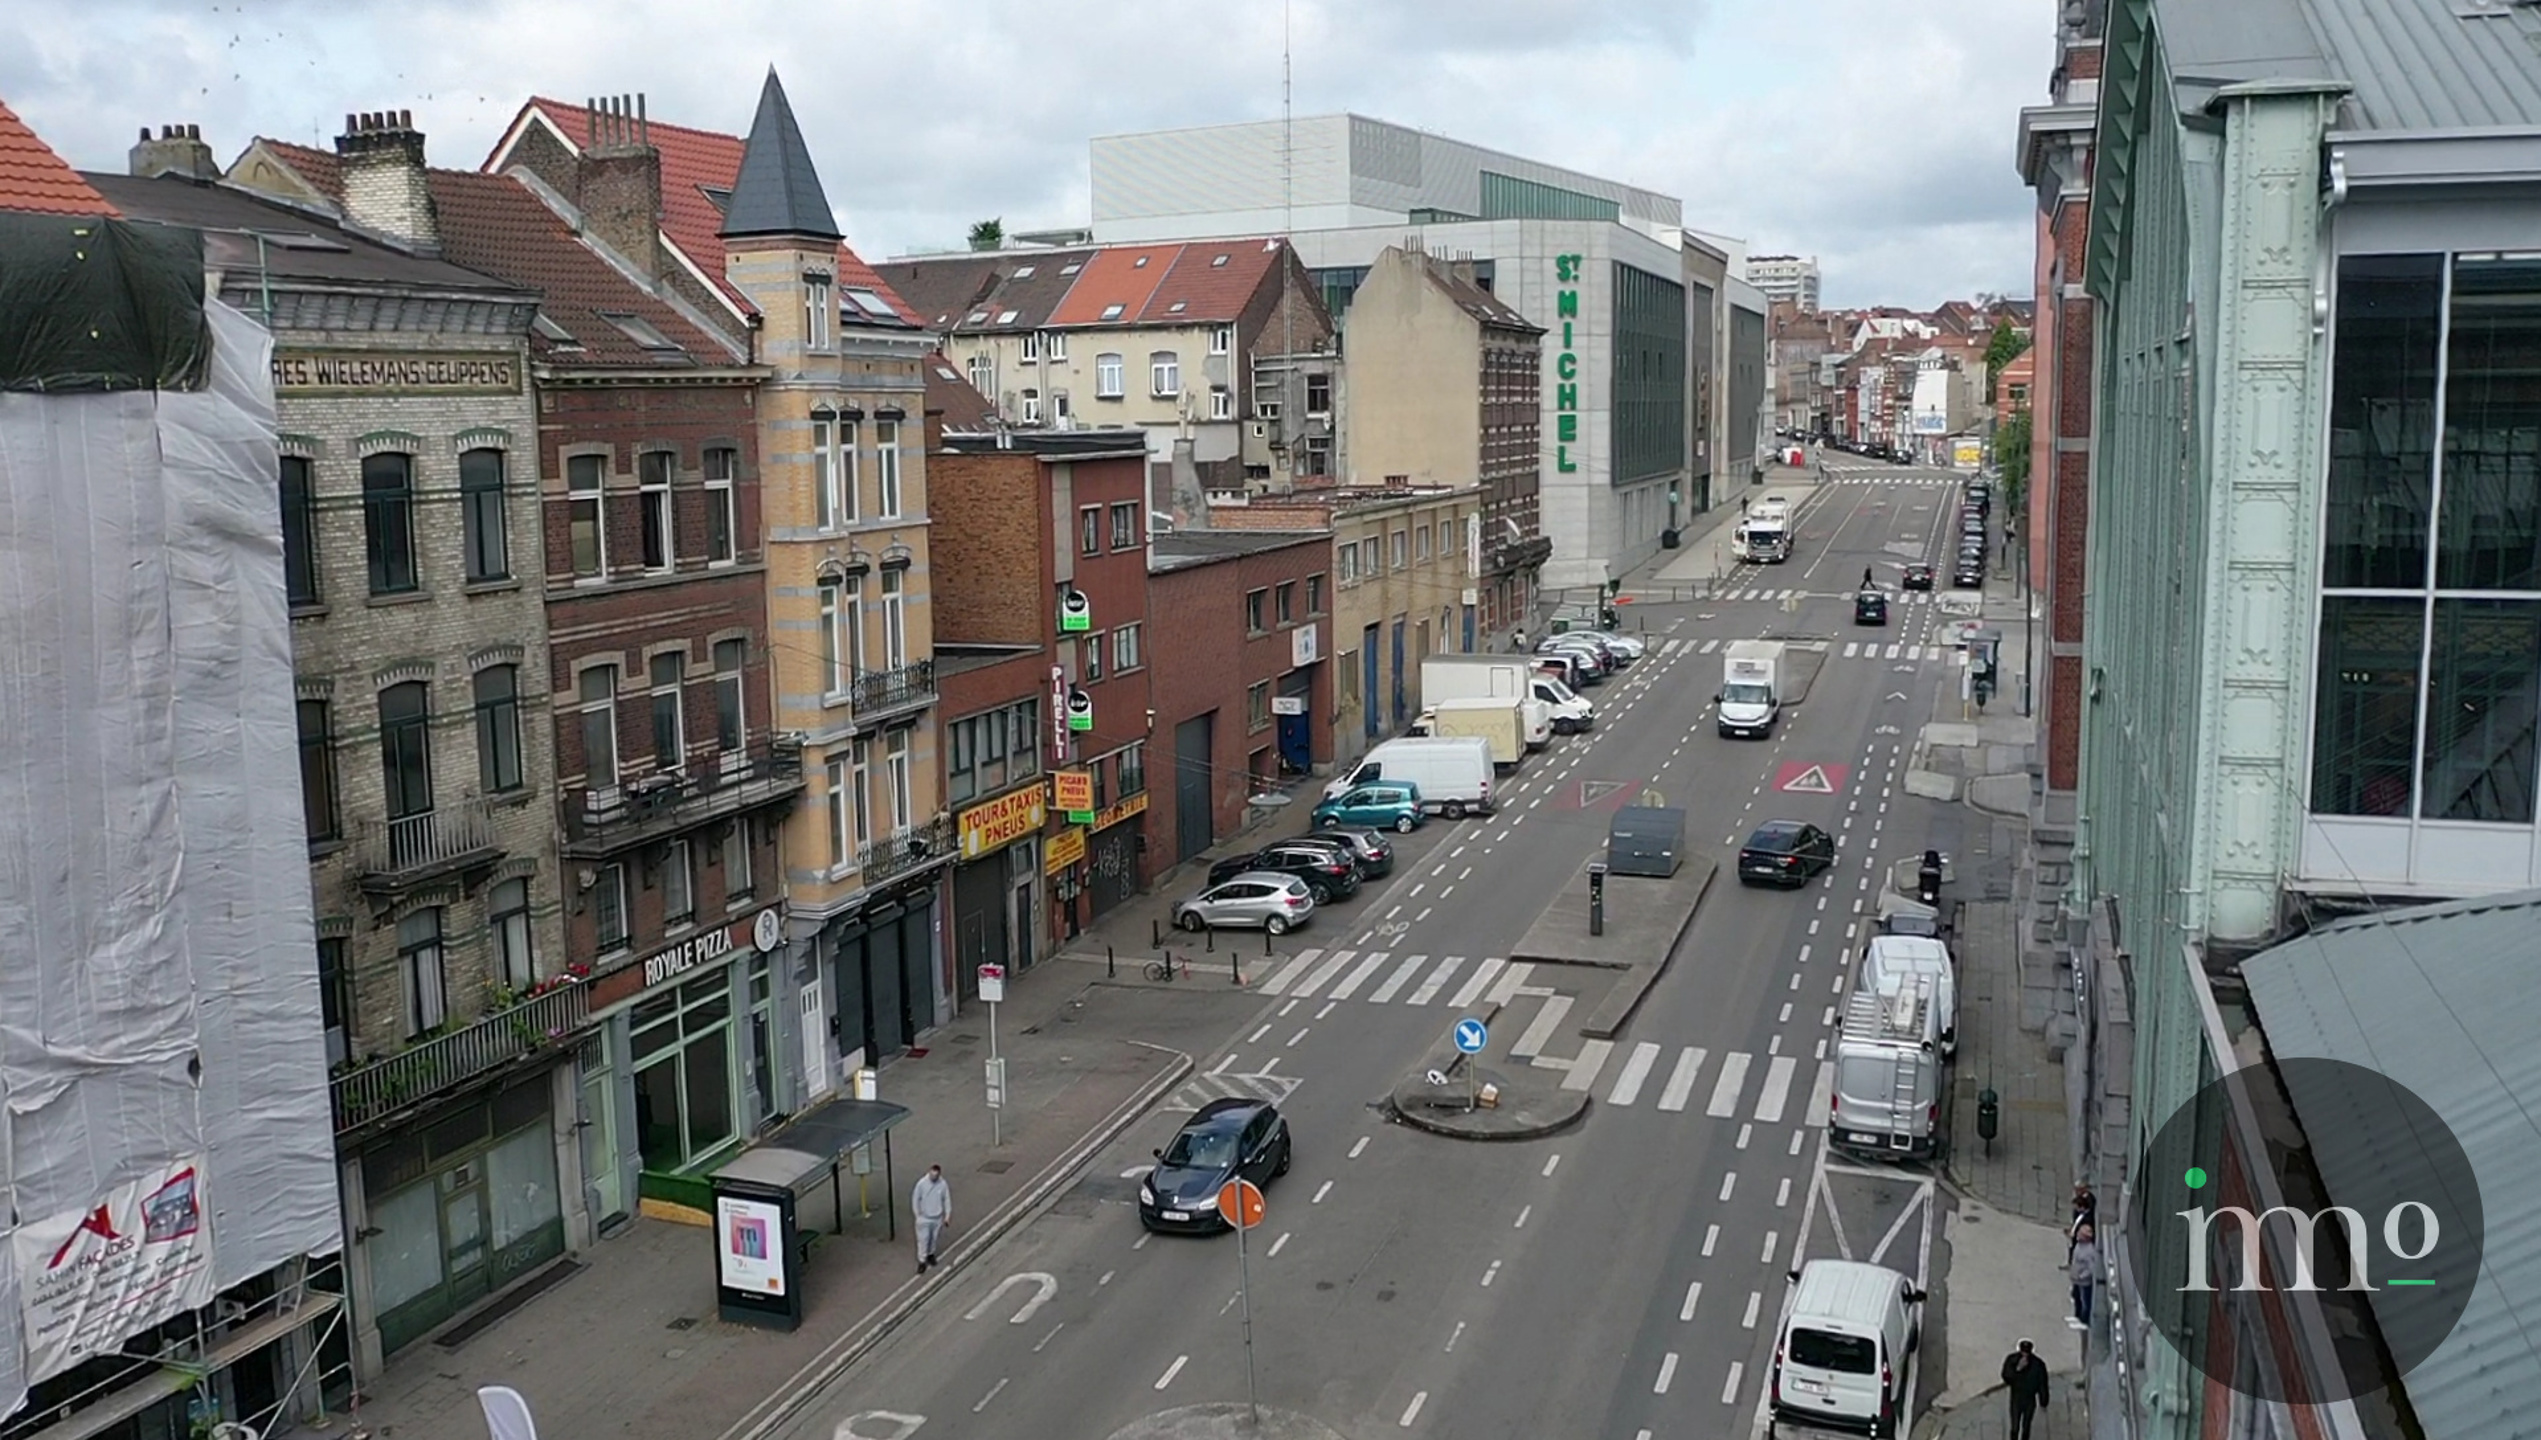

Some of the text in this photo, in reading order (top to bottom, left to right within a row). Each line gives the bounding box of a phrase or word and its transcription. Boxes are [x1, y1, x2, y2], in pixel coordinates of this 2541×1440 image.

[1557, 290, 1577, 473] MICHEL
[1052, 666, 1064, 759] PIRELLI
[965, 786, 1042, 831] TOUR&TAXIS
[985, 814, 1026, 846] PNEUS
[644, 926, 733, 987] ROYALE PIZZA
